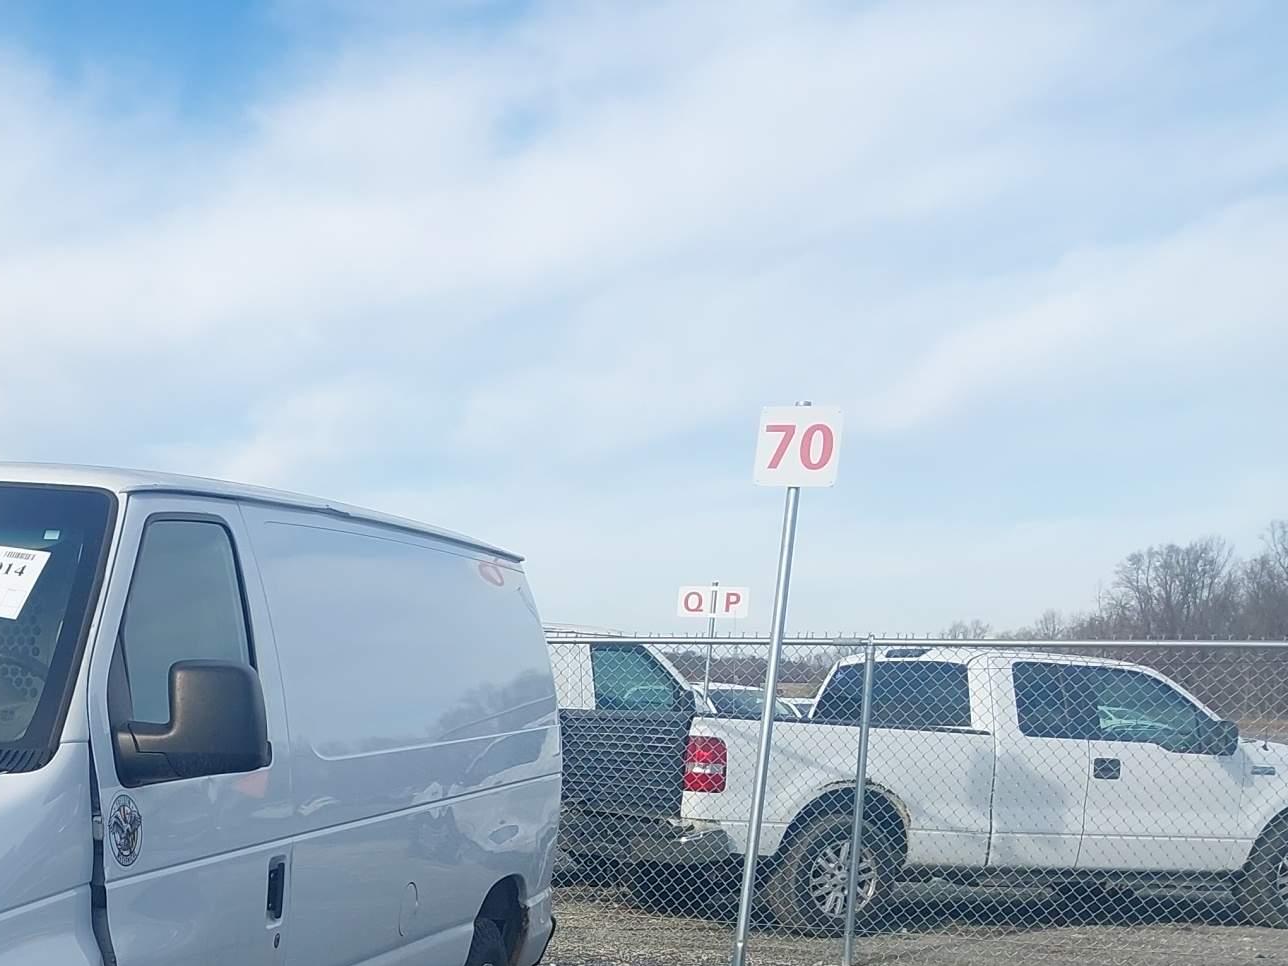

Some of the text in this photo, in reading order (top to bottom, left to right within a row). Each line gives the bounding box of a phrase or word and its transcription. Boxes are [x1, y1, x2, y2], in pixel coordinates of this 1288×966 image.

[765, 423, 834, 470] 70
[683, 591, 741, 613] Q P
